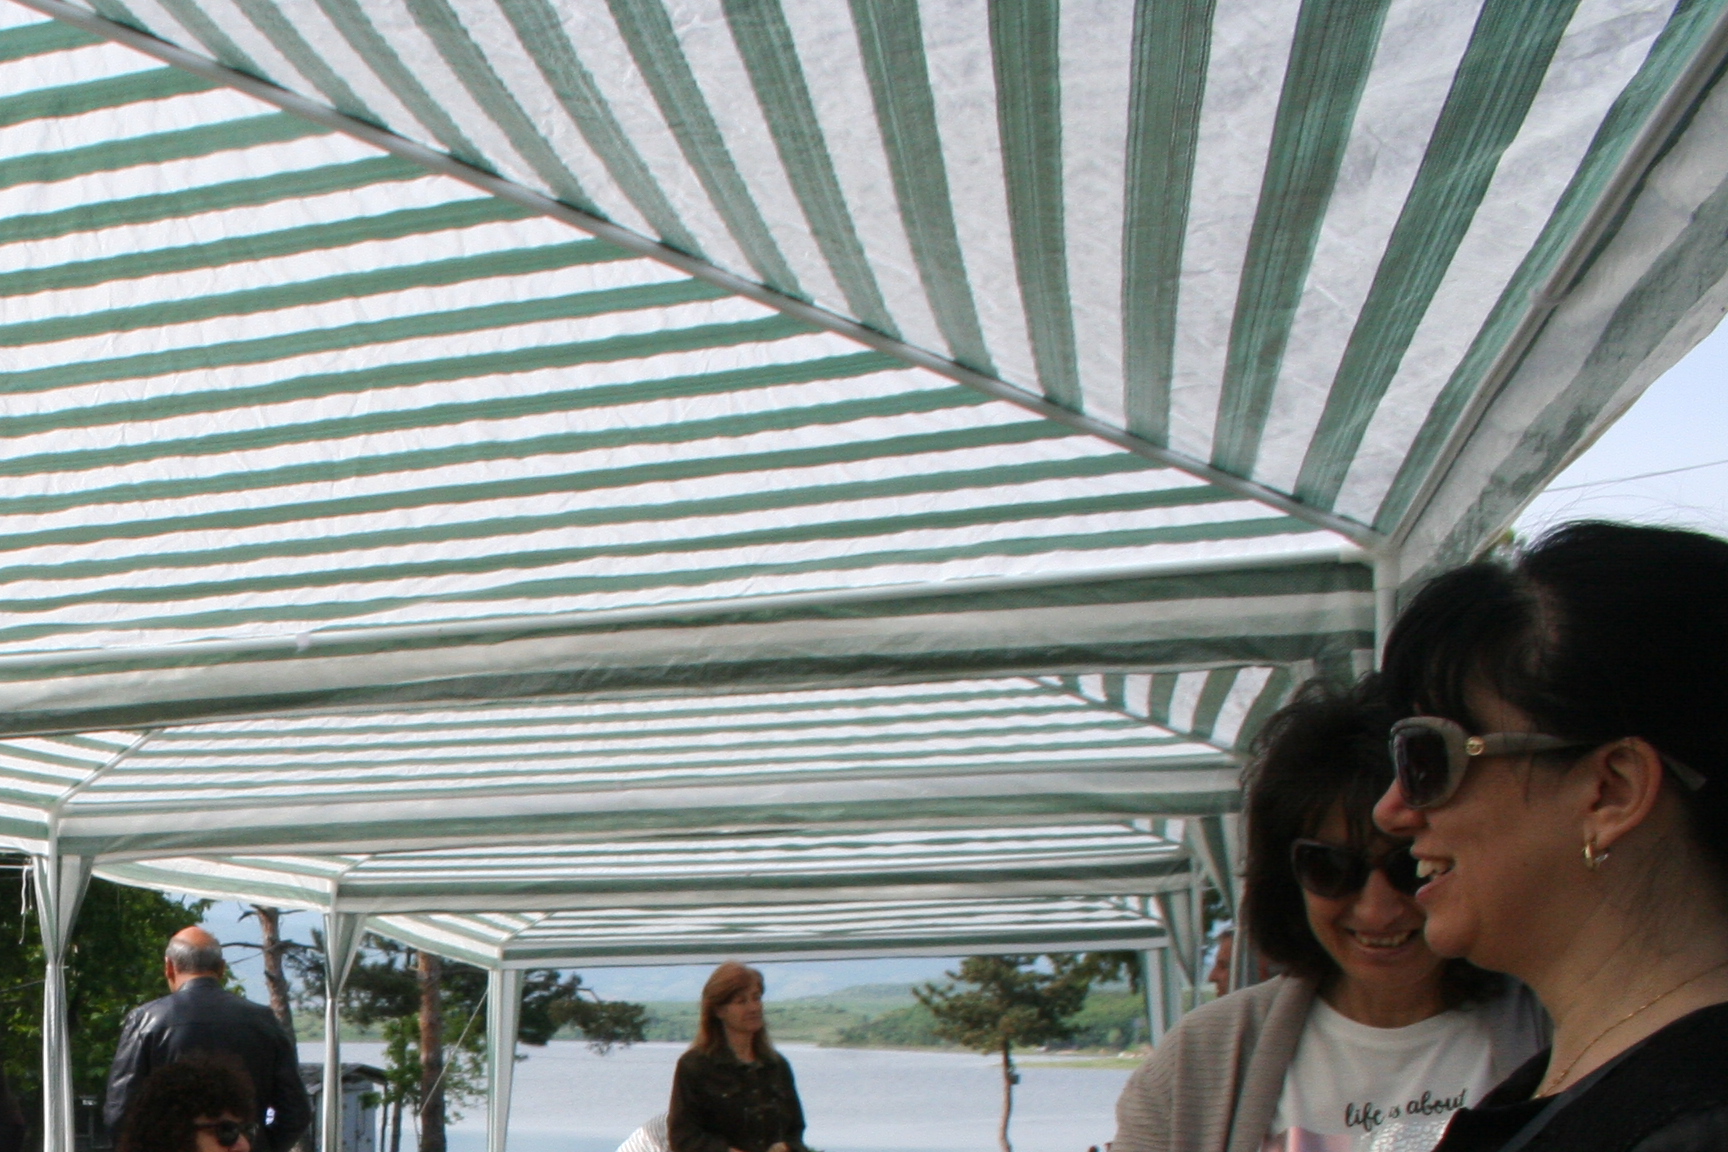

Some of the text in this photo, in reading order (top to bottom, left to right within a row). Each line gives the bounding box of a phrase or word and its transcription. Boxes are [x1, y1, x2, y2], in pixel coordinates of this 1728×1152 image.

[1345, 1088, 1467, 1132] life is about
